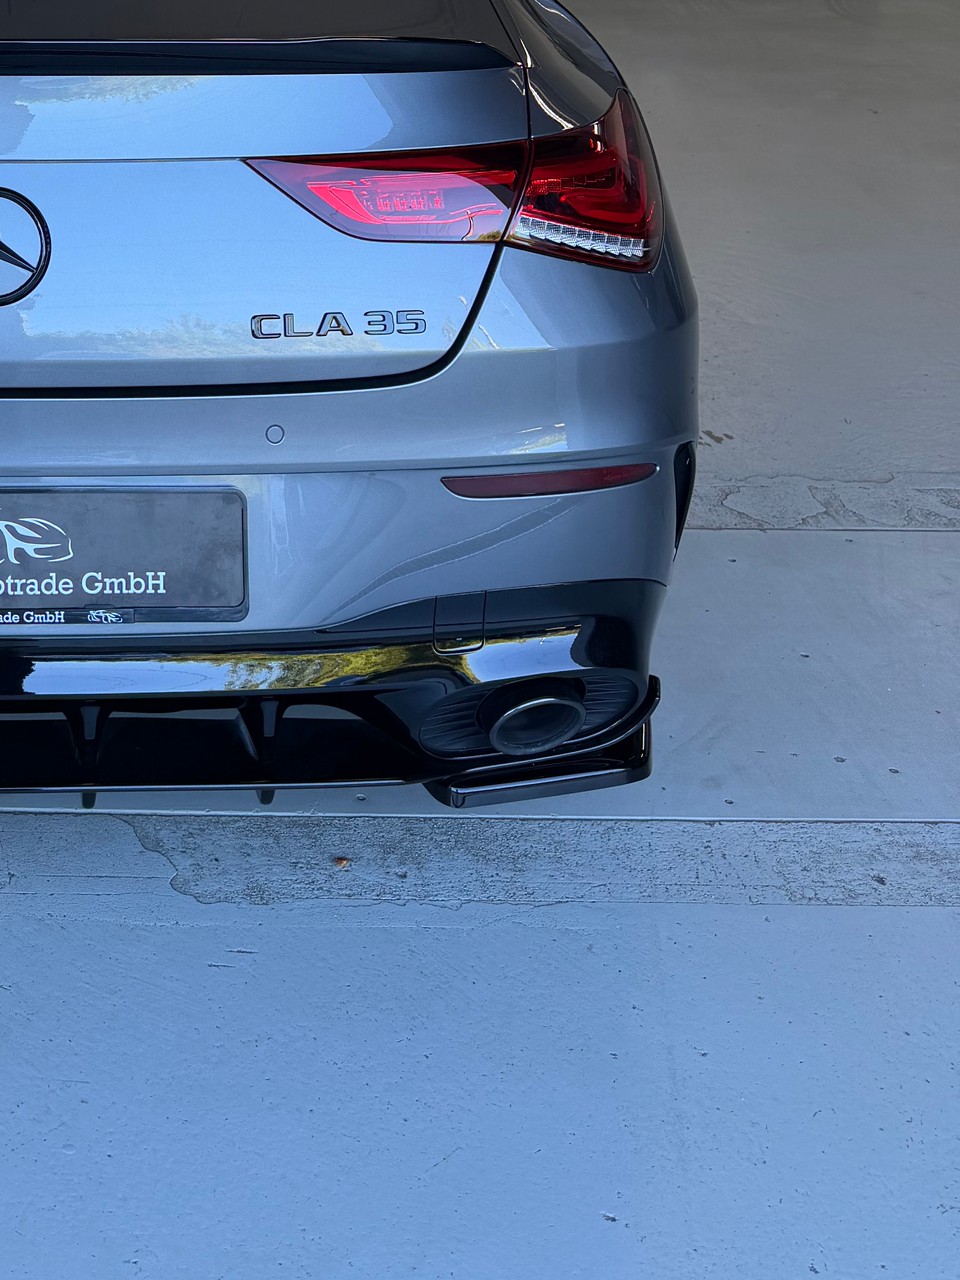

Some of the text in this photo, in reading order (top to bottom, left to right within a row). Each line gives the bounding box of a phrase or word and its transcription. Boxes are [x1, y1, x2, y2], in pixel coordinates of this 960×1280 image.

[250, 309, 427, 339] CLA 35
[81, 572, 166, 595] GmbH
[23, 610, 65, 623] GmbH
